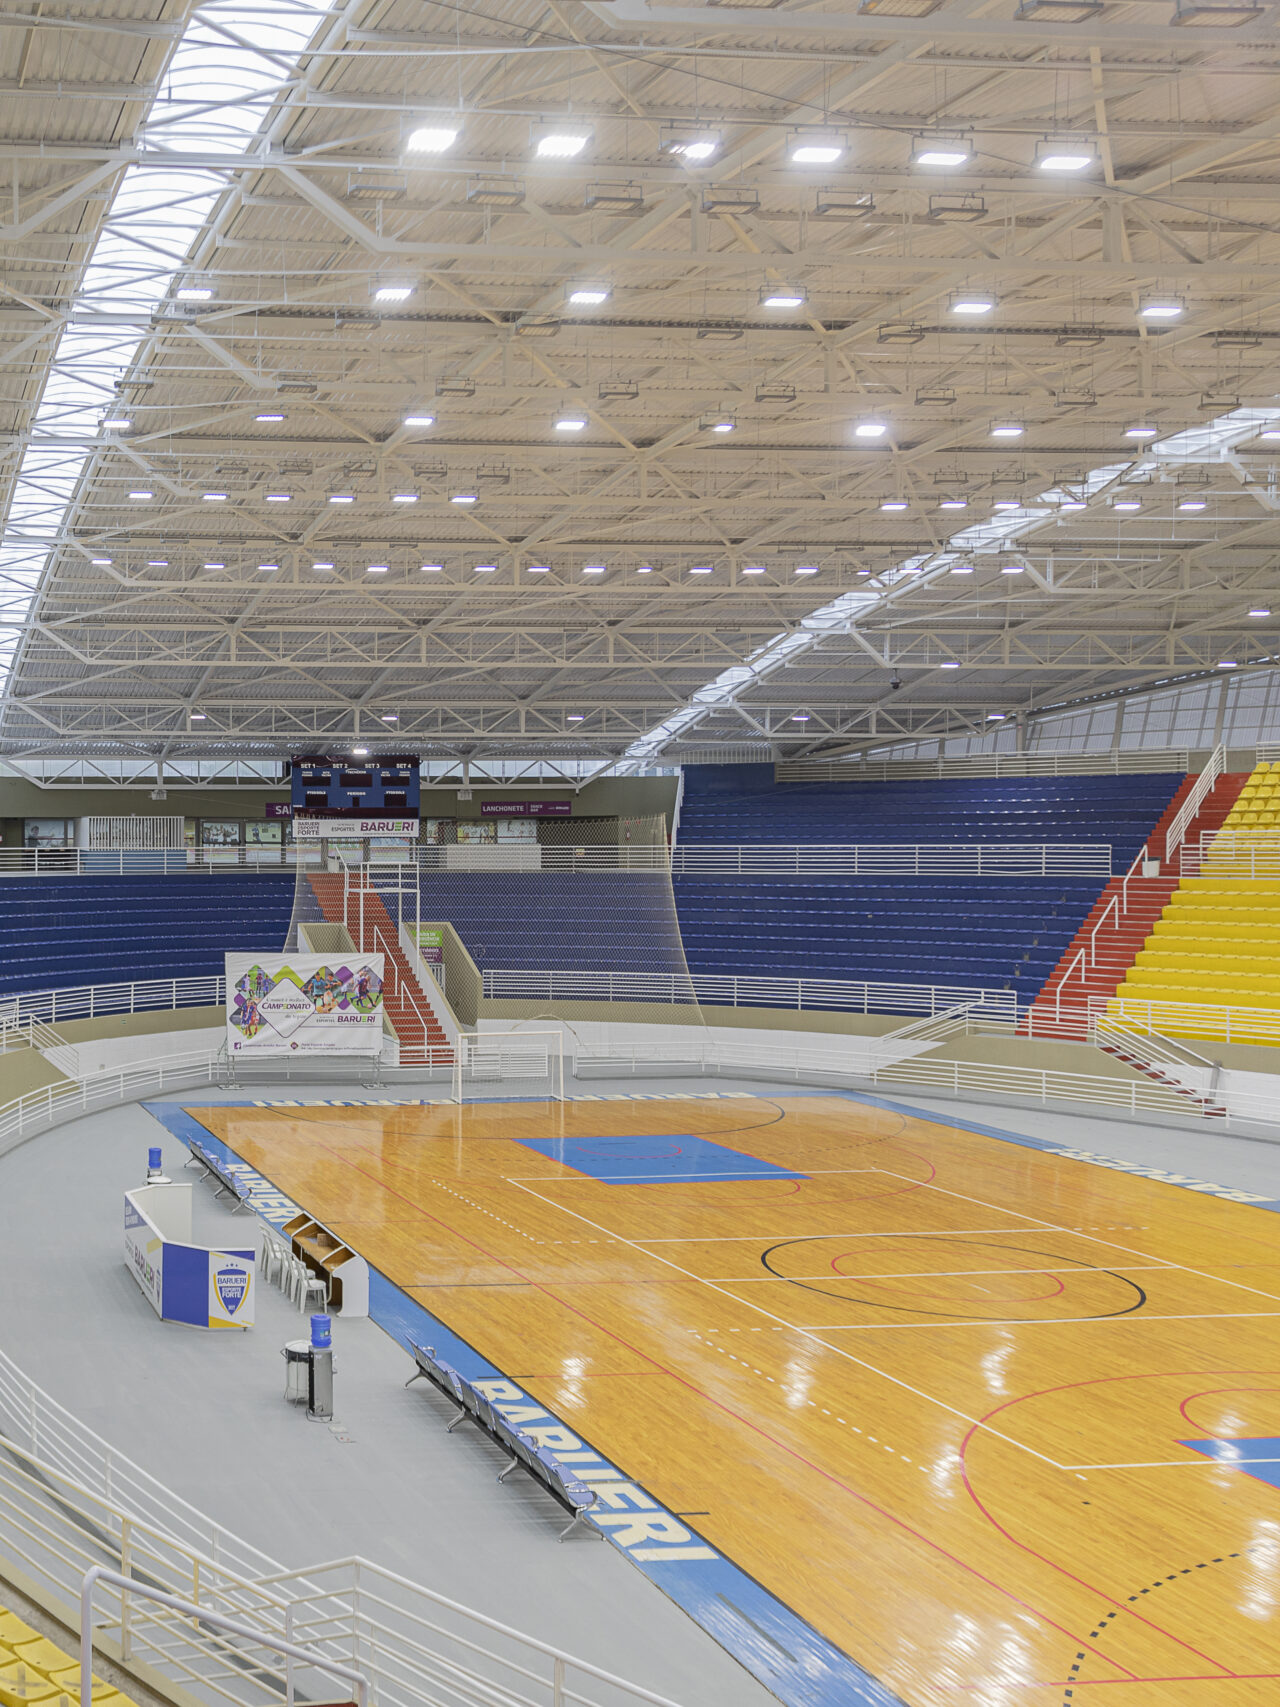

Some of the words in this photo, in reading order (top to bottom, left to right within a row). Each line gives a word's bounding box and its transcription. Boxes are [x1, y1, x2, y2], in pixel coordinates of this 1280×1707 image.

[360, 821, 415, 832] BARUERI
[261, 1002, 312, 1010] CAMPEONATO
[337, 1015, 376, 1023] BARUERI
[1042, 1148, 1278, 1202] BARUERI
[217, 1277, 247, 1285] BARUERI
